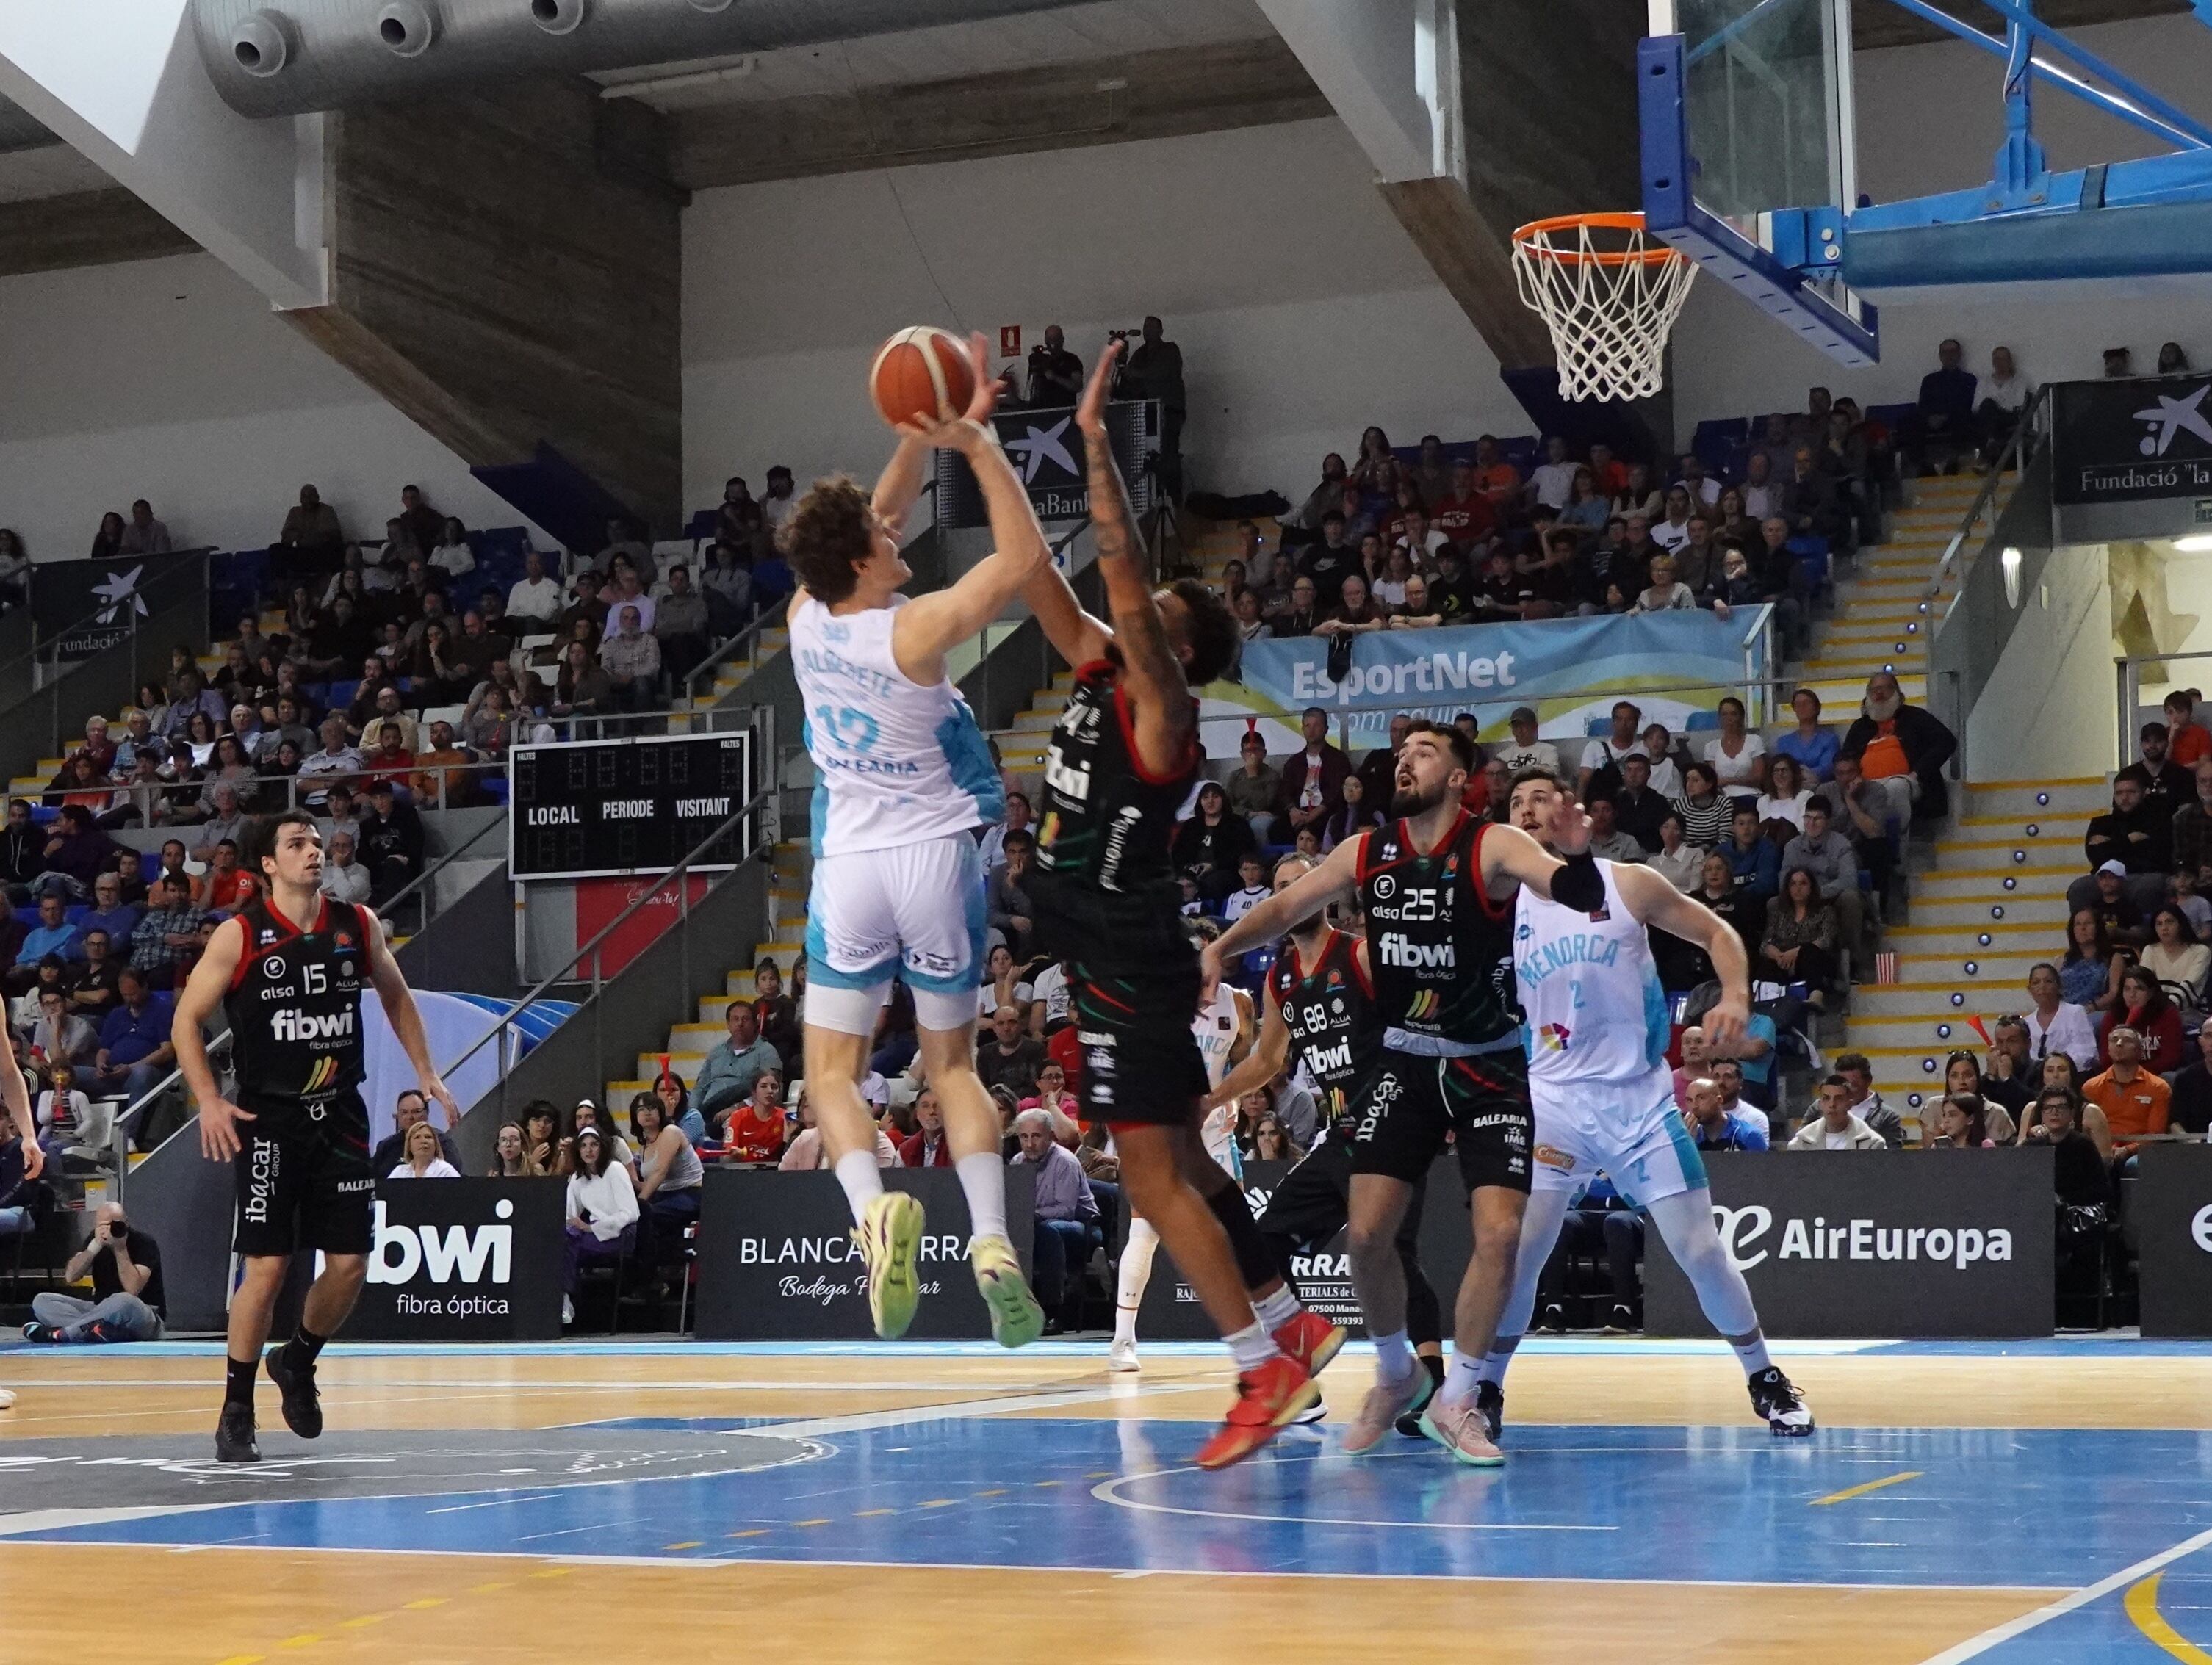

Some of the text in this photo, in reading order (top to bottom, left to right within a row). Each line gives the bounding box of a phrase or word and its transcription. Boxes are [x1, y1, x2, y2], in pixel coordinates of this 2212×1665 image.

[2080, 466, 2178, 491] Fundació
[1292, 650, 1516, 705] EsportNet
[528, 805, 580, 826] LOCAL
[602, 799, 654, 820] PERIODE
[676, 797, 731, 818] VISITANT
[1372, 905, 1400, 920] alsa
[1401, 888, 1438, 922] 25
[1379, 931, 1456, 969] fibwi
[1516, 933, 1622, 990] MENORCA
[260, 985, 295, 1000] alsa
[303, 963, 328, 995] 15
[335, 980, 359, 989] ALUA
[1568, 979, 1586, 1009] 2
[270, 1003, 354, 1041] fibwi
[1303, 1003, 1327, 1033] 88
[1330, 1014, 1352, 1025] ALUA
[1303, 1035, 1352, 1075] ibwi
[271, 1143, 281, 1177] GROUP
[245, 1136, 271, 1224] ibacar
[366, 1199, 514, 1285] bwi
[1779, 1218, 2013, 1271] AirEuropa
[779, 1275, 851, 1306] Bodega
[1339, 1285, 1352, 1297] de
[397, 1293, 510, 1320] fibra óptica
[1308, 1304, 1336, 1313] 07500
[1331, 1317, 1364, 1326] 559393
